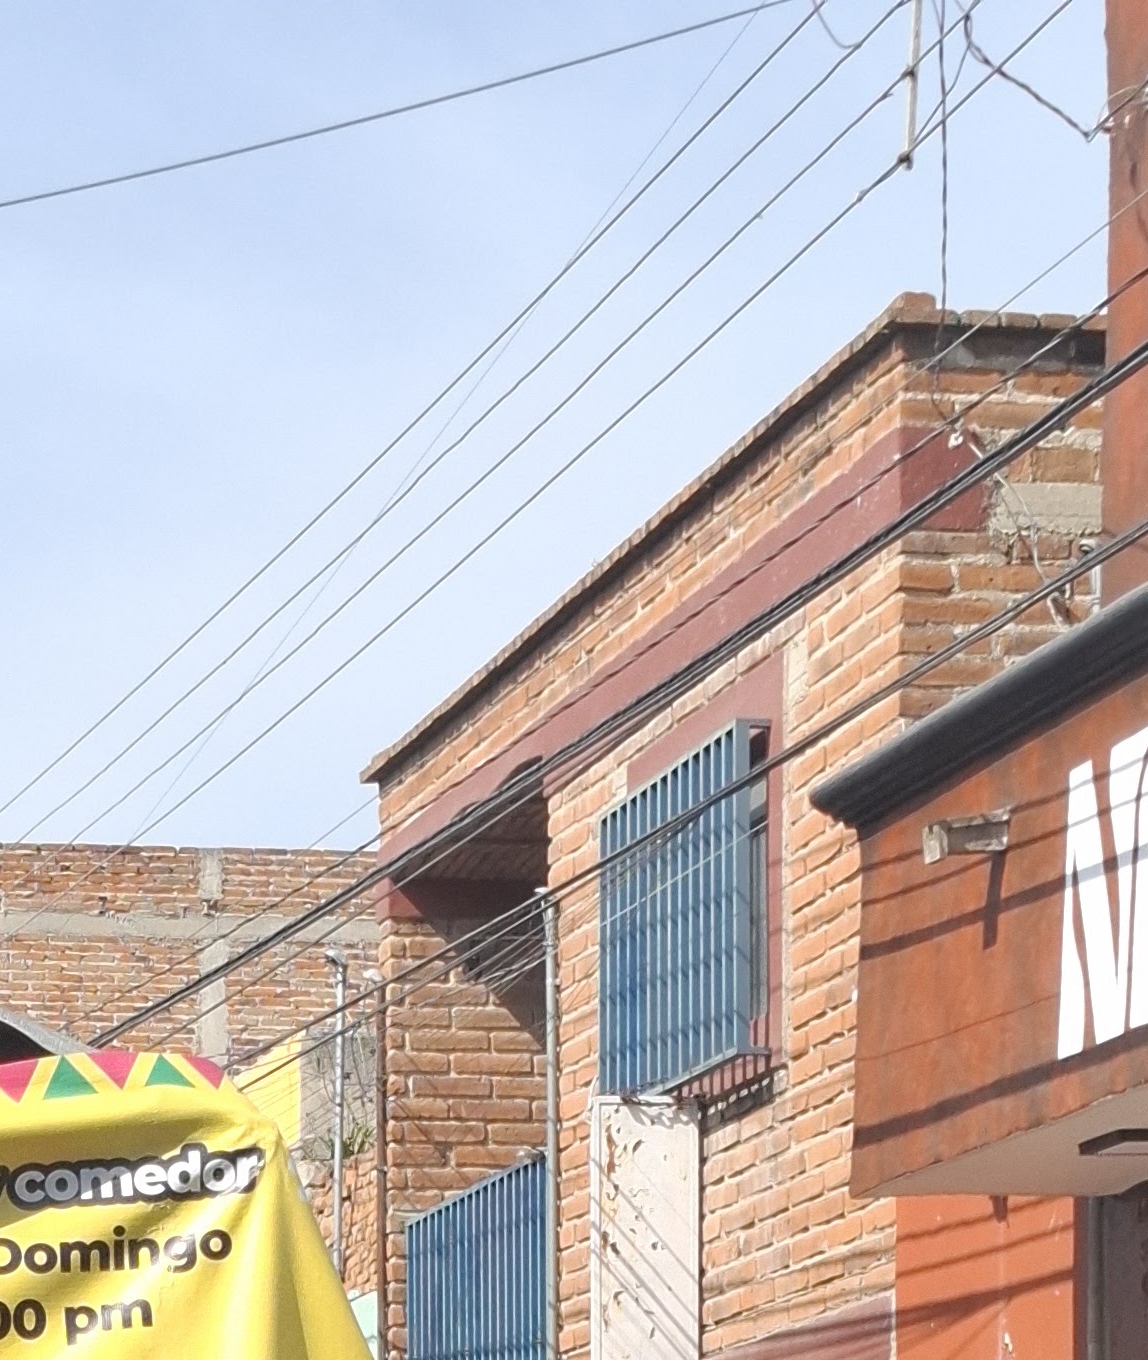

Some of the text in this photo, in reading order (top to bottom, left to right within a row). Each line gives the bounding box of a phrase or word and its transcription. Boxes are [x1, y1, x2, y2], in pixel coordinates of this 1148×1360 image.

[1057, 724, 1148, 1060] N
[13, 1149, 264, 1201] comedor
[64, 1297, 154, 1346] pm
